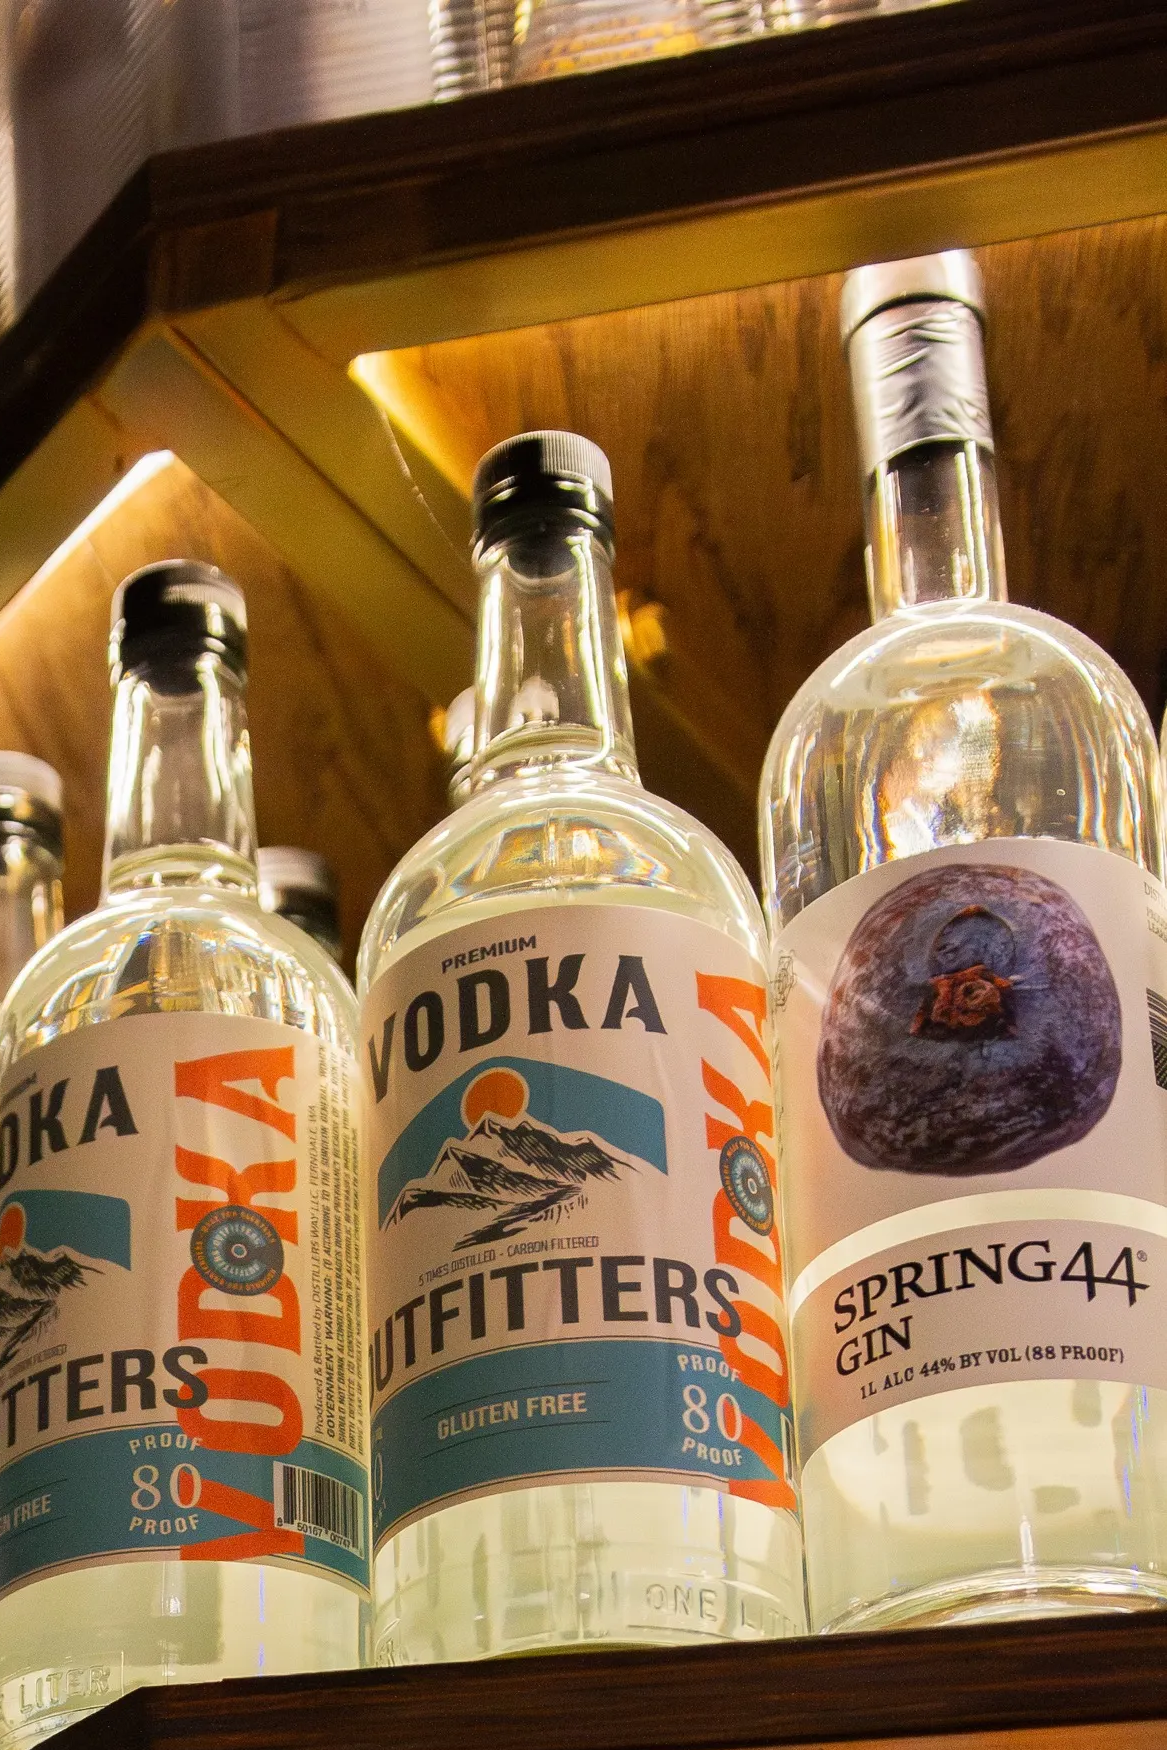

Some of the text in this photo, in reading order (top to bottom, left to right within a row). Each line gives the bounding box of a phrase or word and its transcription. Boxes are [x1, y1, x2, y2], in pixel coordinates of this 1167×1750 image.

[441, 934, 537, 974] PREMIUM
[367, 953, 669, 1105] VODKA
[308, 1105, 317, 1122] WA
[320, 1171, 330, 1186] THE
[321, 1189, 330, 1201] TO
[310, 1213, 319, 1238] WAY
[695, 970, 798, 1511] VODKA
[311, 1241, 321, 1303] DISTILLERS
[417, 1274, 425, 1287] 5
[426, 1262, 449, 1281] TIMES
[451, 1249, 496, 1274] DISTILLED
[507, 1240, 549, 1257] CARBON
[550, 1235, 600, 1251] FILTERED
[175, 1044, 307, 1562] VODKA
[313, 1306, 323, 1320] by
[313, 1323, 324, 1365] Bottled
[836, 1316, 913, 1377] GIN
[313, 1367, 323, 1377] &
[336, 1356, 345, 1384] DRINK
[677, 1353, 742, 1383] PROOF
[860, 1345, 1125, 1400] 1L ALC 44% BY VOL (88 PROOF)
[313, 1379, 325, 1434] Produced
[325, 1344, 335, 1438] GOVERNMENT
[337, 1385, 345, 1405] NOT
[338, 1407, 346, 1443] SHOULD
[437, 1391, 588, 1441] GLUTEN FREE
[682, 1383, 743, 1444] 80
[129, 1432, 205, 1456] PROOF
[681, 1438, 742, 1468] PROOF
[130, 1461, 204, 1513] 80
[14, 1493, 52, 1528] FREE
[129, 1513, 203, 1538] PROOF
[645, 1583, 719, 1623] ONE
[19, 1665, 111, 1715] LITER
